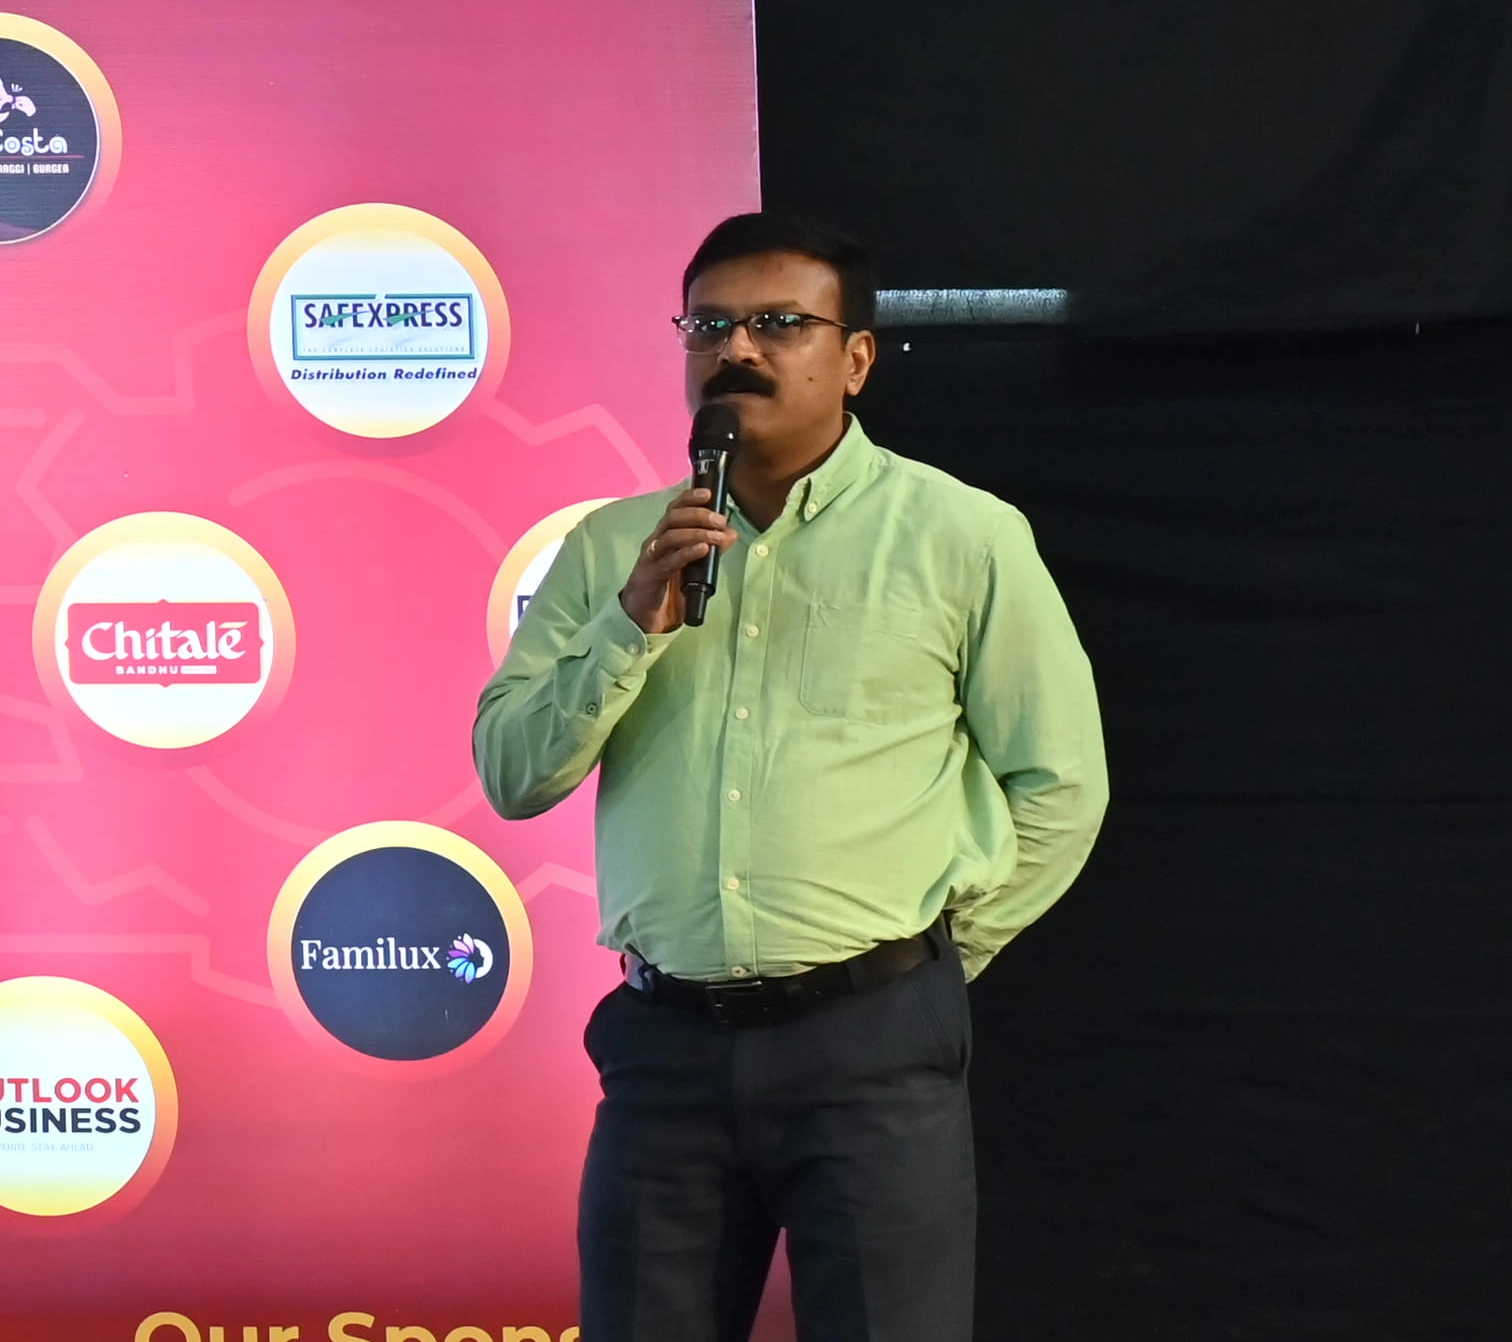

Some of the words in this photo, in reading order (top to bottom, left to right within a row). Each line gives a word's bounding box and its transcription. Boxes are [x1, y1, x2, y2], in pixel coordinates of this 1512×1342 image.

[304, 302, 463, 328] SAFEXPRESS
[291, 369, 387, 380] Distribution
[394, 368, 477, 379] Redefined
[116, 665, 179, 674] BANDHU
[300, 939, 441, 971] Familux
